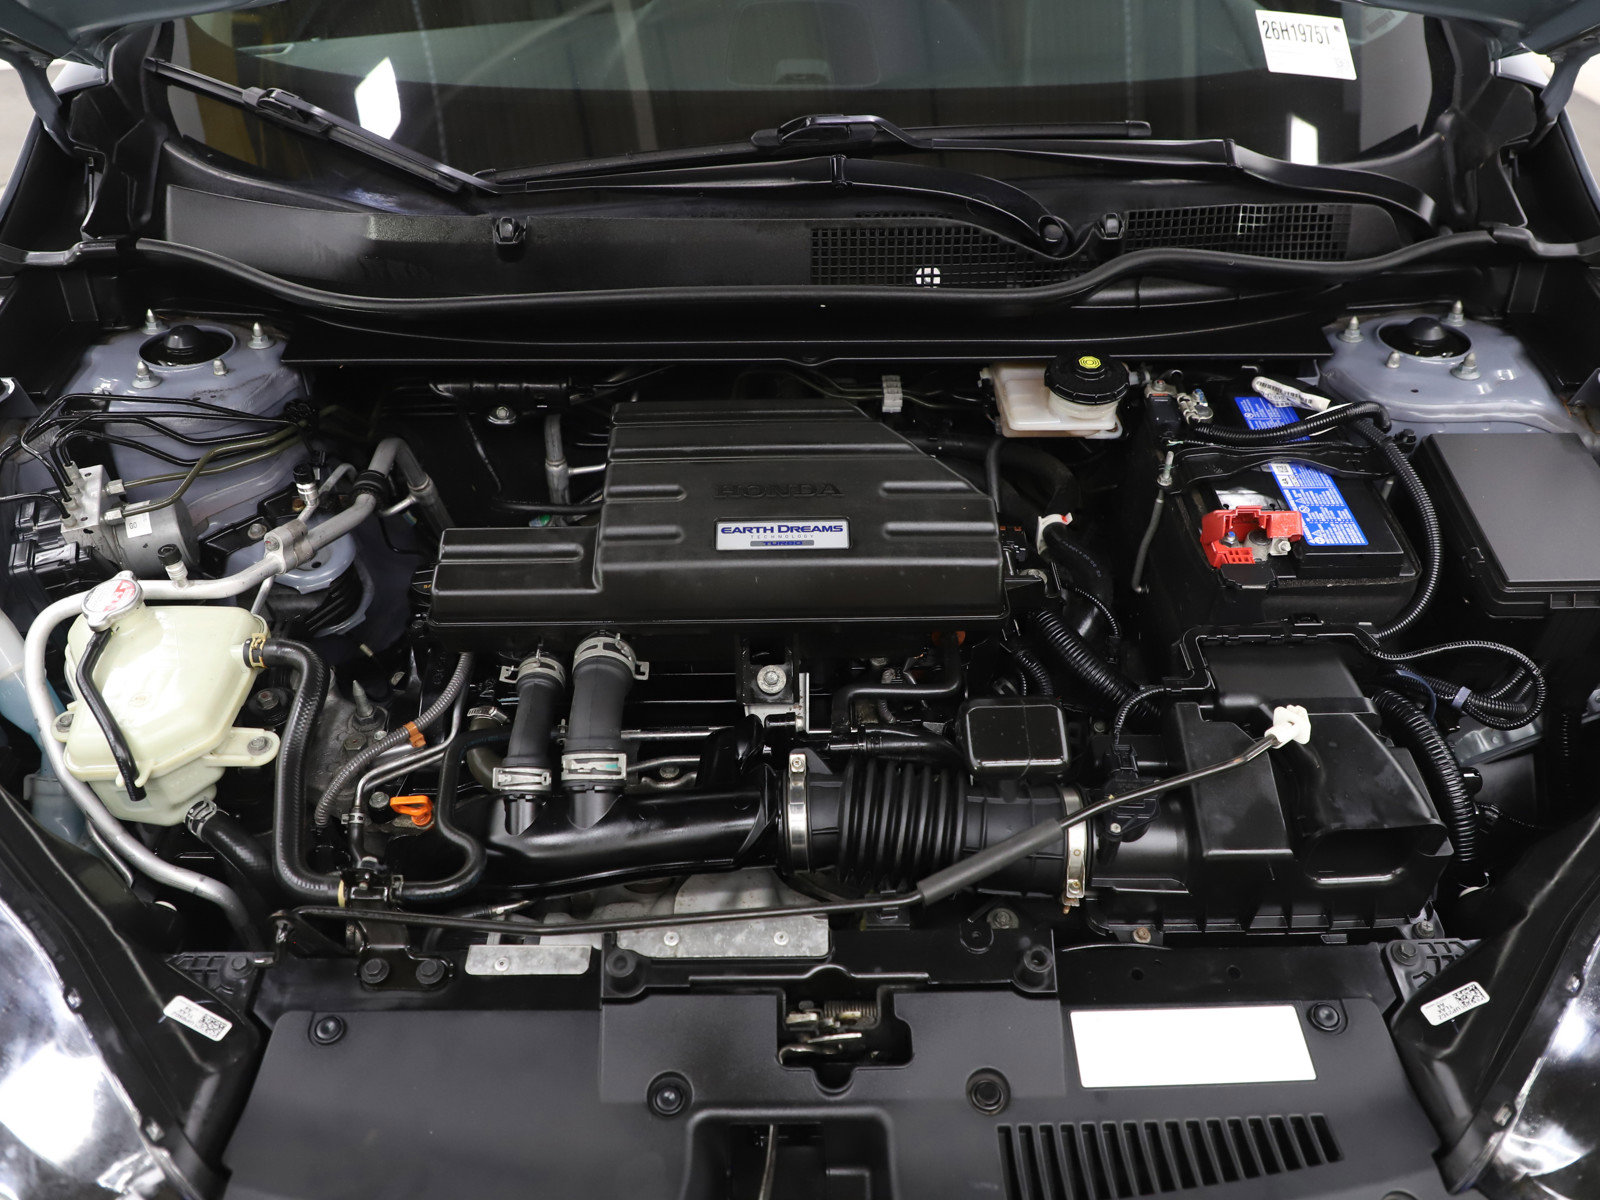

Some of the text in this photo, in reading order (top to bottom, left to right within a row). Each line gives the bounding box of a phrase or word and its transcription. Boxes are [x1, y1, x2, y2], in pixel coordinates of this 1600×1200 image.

[713, 482, 845, 498] HONDA
[721, 524, 844, 534] EARTH DREAMS
